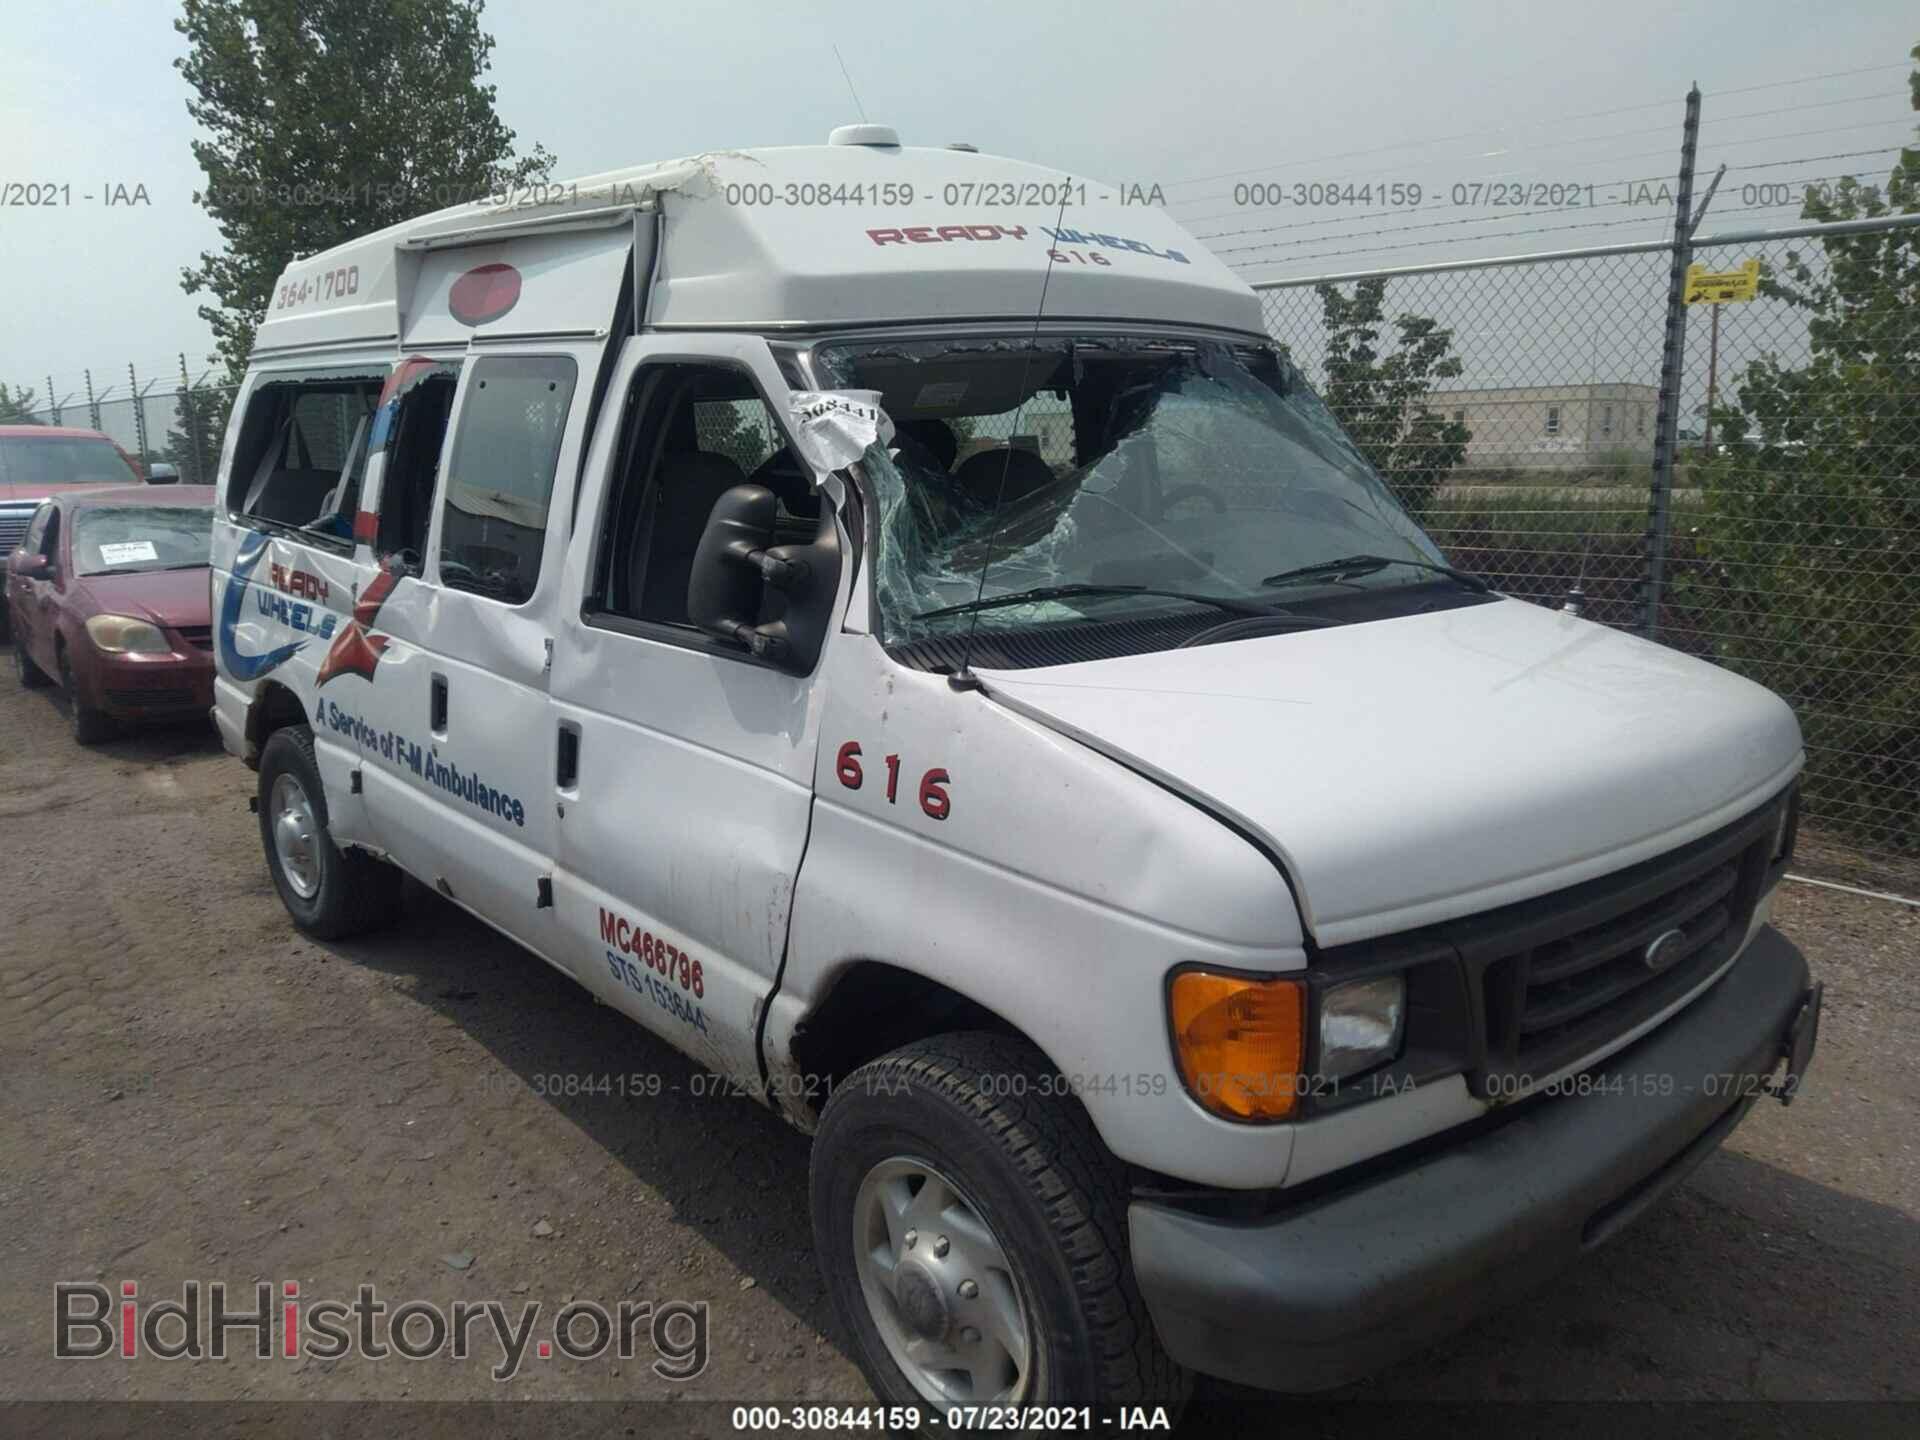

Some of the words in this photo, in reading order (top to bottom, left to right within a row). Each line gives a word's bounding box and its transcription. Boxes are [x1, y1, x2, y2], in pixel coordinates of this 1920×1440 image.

[865, 224, 1028, 247] READY
[1040, 226, 1191, 265] WHEELS
[1046, 249, 1112, 266] 616
[277, 265, 359, 310] 364-1700
[256, 589, 337, 640] WHEELS
[315, 697, 326, 727] A
[329, 701, 378, 751] Service
[379, 730, 394, 760] of
[396, 735, 423, 777] F-M
[424, 752, 525, 828] Ambulance
[836, 741, 952, 821] 616
[600, 907, 704, 1000] MC466796
[606, 950, 643, 994] STS
